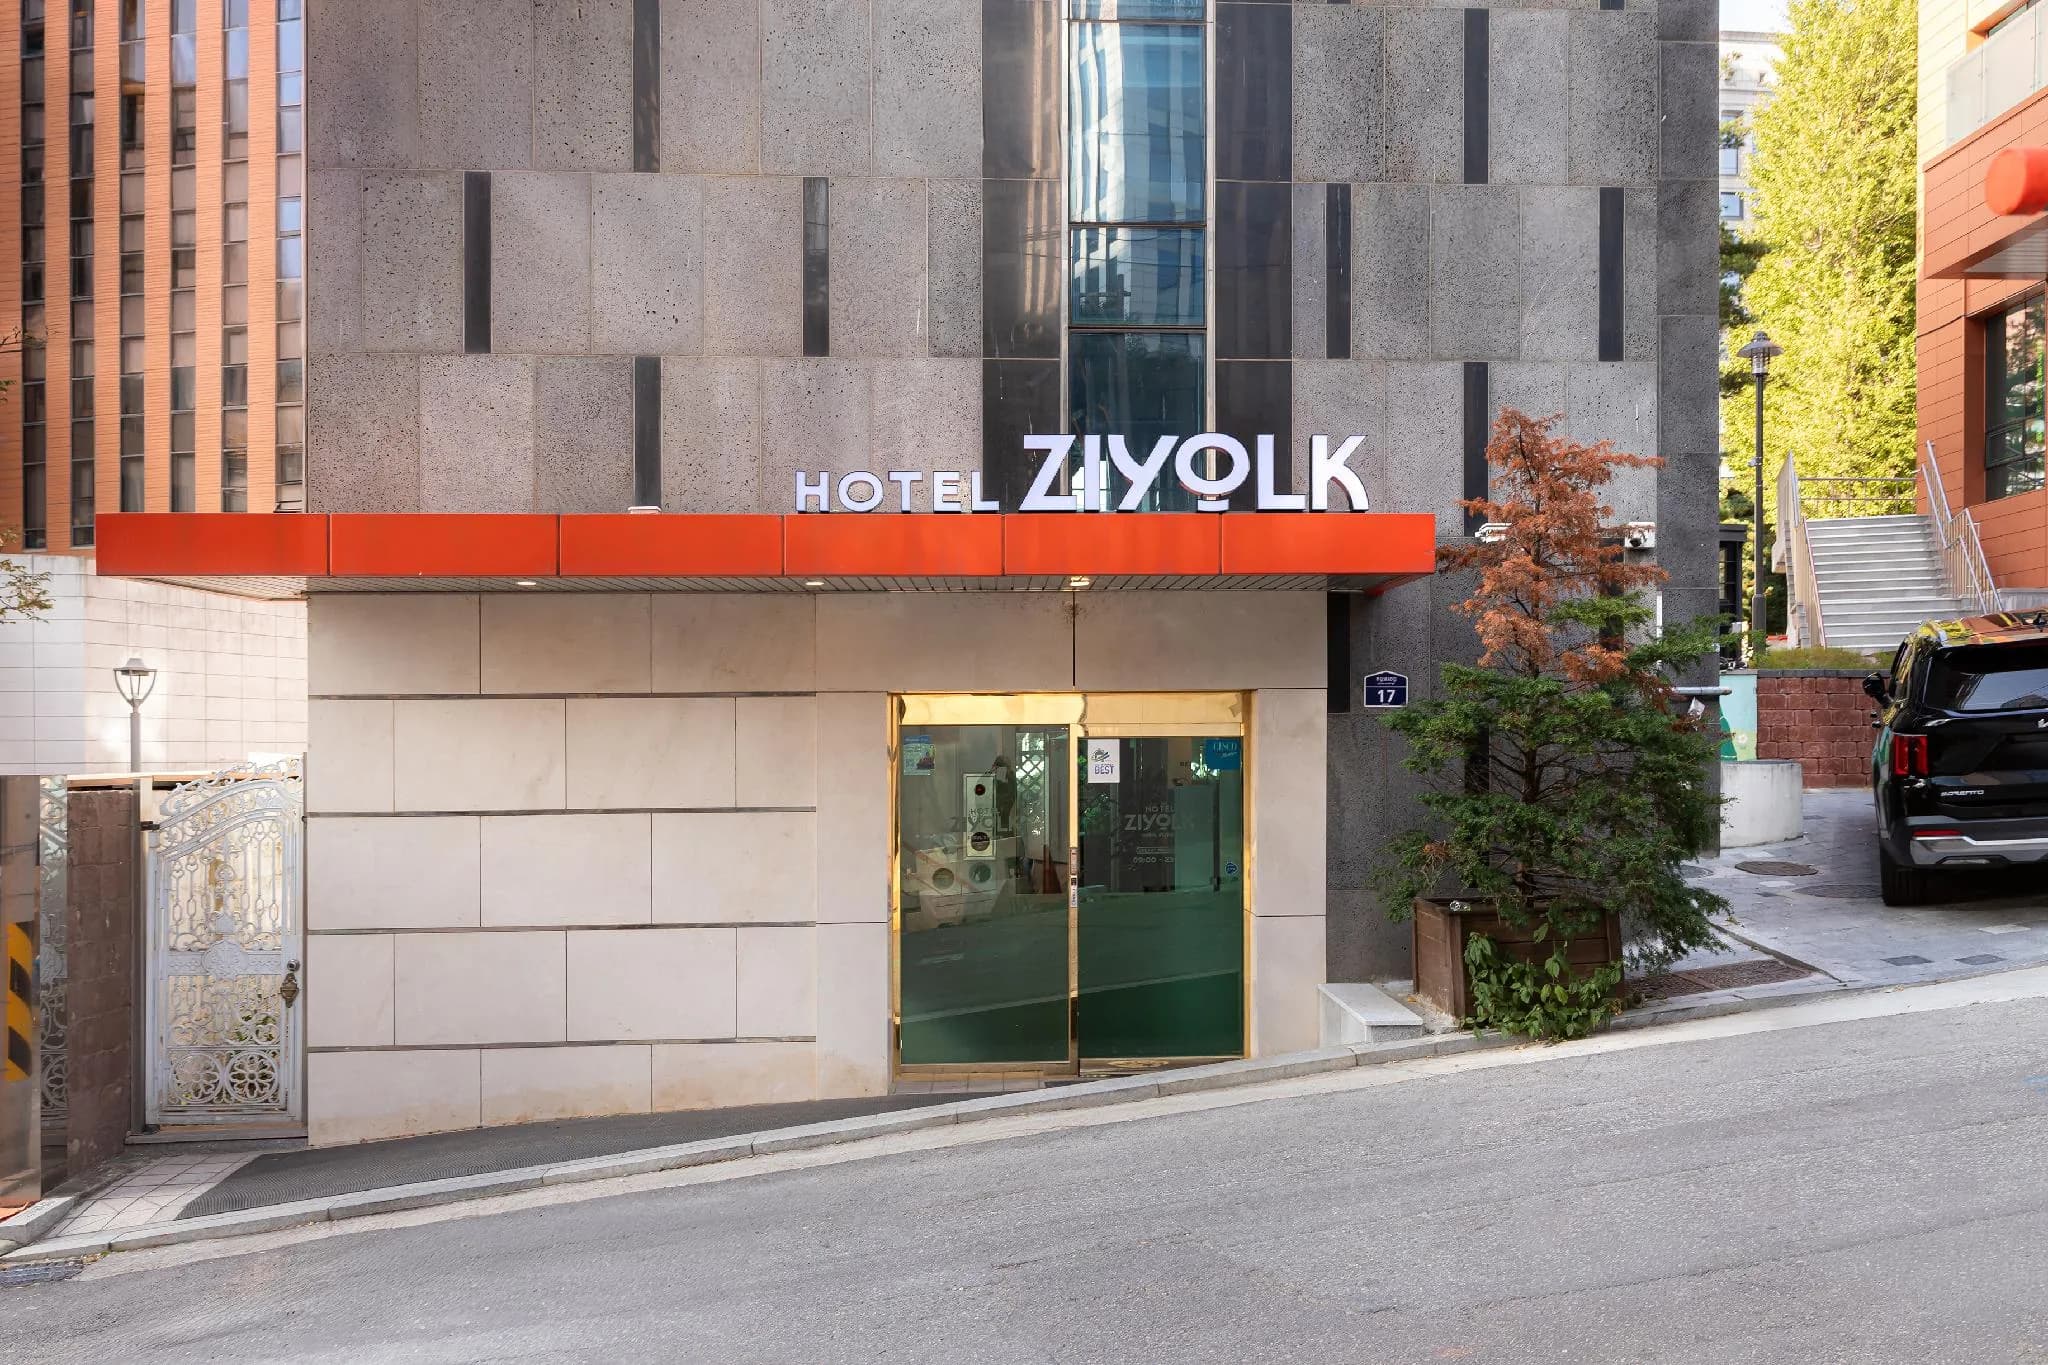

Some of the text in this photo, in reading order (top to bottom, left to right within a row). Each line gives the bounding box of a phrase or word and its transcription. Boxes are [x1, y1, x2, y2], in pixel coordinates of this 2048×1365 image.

[796, 432, 1370, 513] HOTEL ZIYOLK
[1377, 689, 1396, 703] 17
[1095, 762, 1115, 775] BEST
